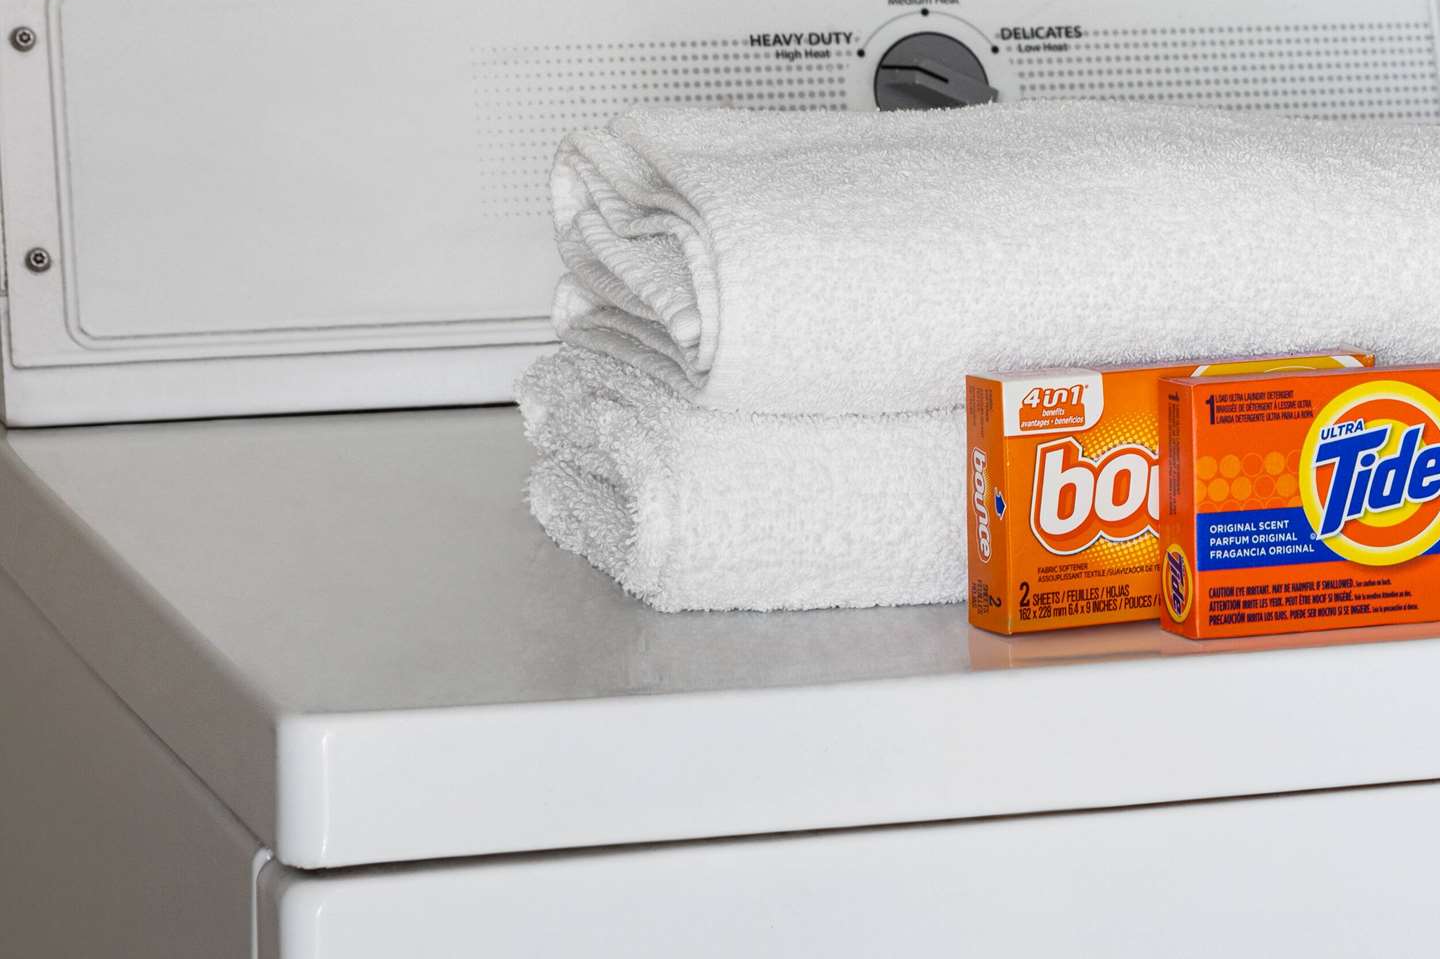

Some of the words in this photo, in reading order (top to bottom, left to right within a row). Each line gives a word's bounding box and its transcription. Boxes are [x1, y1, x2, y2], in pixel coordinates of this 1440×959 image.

[750, 32, 804, 46] HEAVY
[808, 31, 853, 45] DUTY
[1000, 25, 1082, 40] DELICATES
[775, 49, 802, 61] High
[804, 48, 830, 59] Heat
[1018, 43, 1040, 53] Low
[1043, 43, 1068, 52] Heat
[1205, 394, 1215, 425] 1
[1321, 420, 1364, 440] ULTRA
[1038, 447, 1159, 535] bo
[973, 450, 990, 558] bounce
[1209, 522, 1257, 534] ORIGINAL
[1259, 519, 1289, 531] SCENT
[1209, 535, 1249, 547] PARFUM
[1251, 532, 1298, 544] ORIGINAL
[1209, 547, 1266, 559] FRAGANCIA
[1268, 543, 1315, 555] ORIGINAL
[1037, 565, 1058, 574] FABRIC
[1059, 563, 1088, 573] SOFTENER
[1167, 551, 1184, 616] Tide
[1020, 582, 1030, 607] 2
[1033, 591, 1060, 606] SHEETS
[1067, 587, 1099, 601] FEUILLES
[1106, 584, 1130, 598] HOJAS
[1208, 585, 1235, 599] CAUTION
[1053, 606, 1067, 617] mm
[1086, 601, 1091, 614] 9
[1092, 598, 1118, 612] INCHES
[1124, 595, 1152, 609] POUCES
[1208, 599, 1241, 612] ATTENTION
